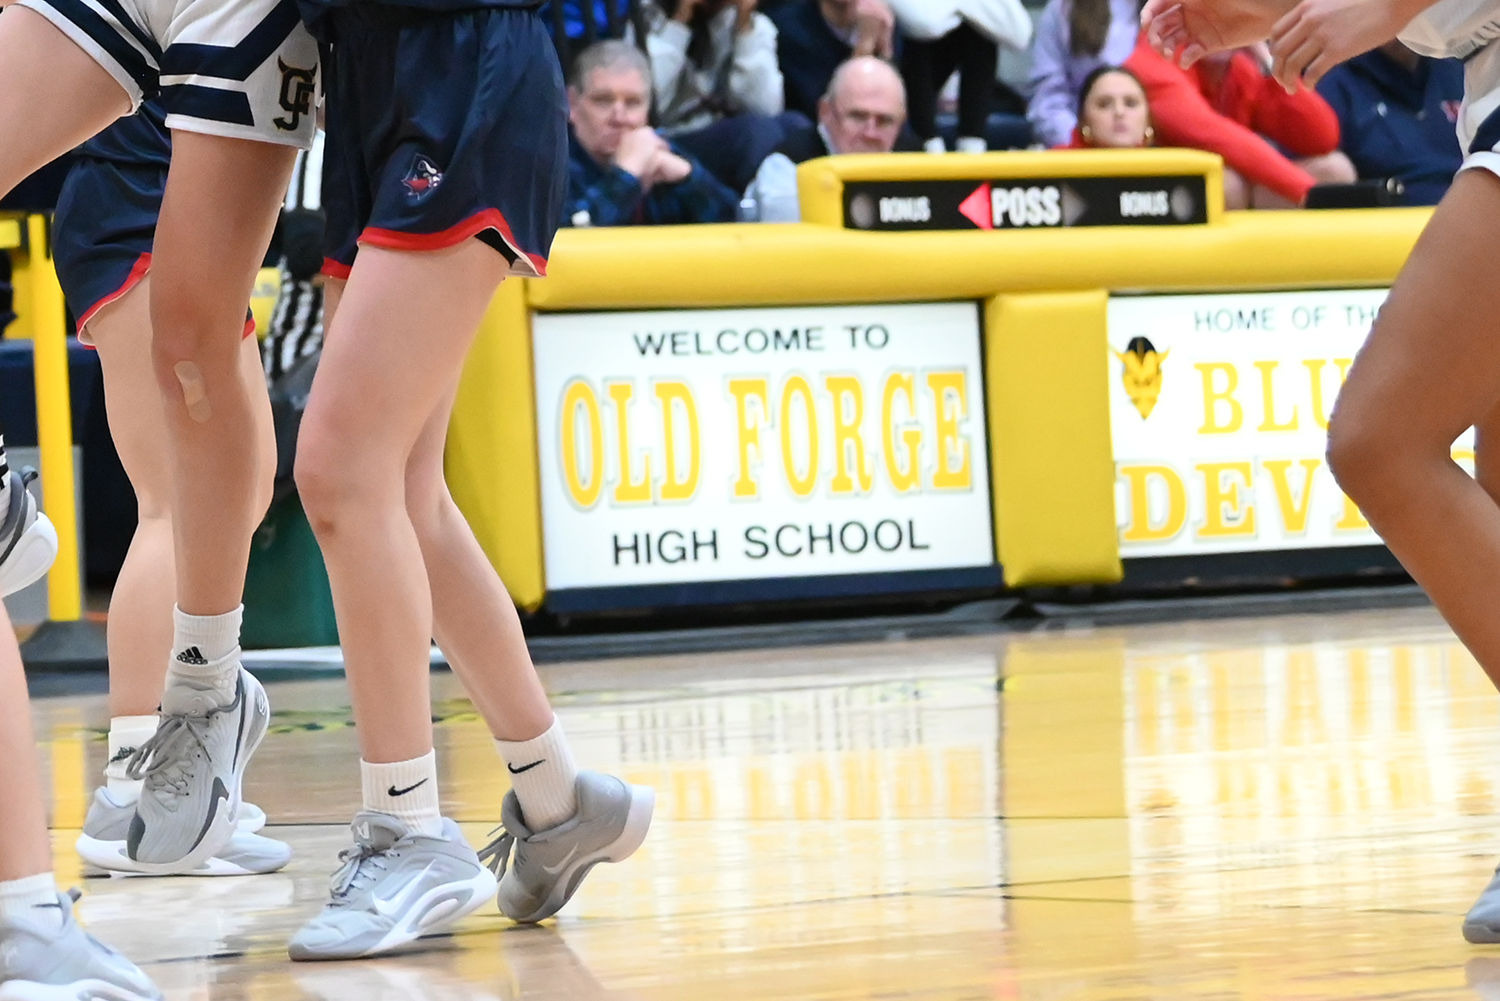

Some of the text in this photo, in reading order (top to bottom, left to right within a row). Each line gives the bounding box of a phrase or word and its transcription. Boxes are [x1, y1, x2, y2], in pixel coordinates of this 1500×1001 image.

[879, 186, 1169, 226] BONUS POSS BONUS
[633, 324, 890, 357] WELCOME TO
[1194, 308, 1275, 333] HOME
[1291, 307, 1327, 331] OF
[1193, 358, 1353, 435] BLU
[557, 365, 974, 512] OLD FORGE
[612, 518, 930, 566] HIGH SCHOOL
